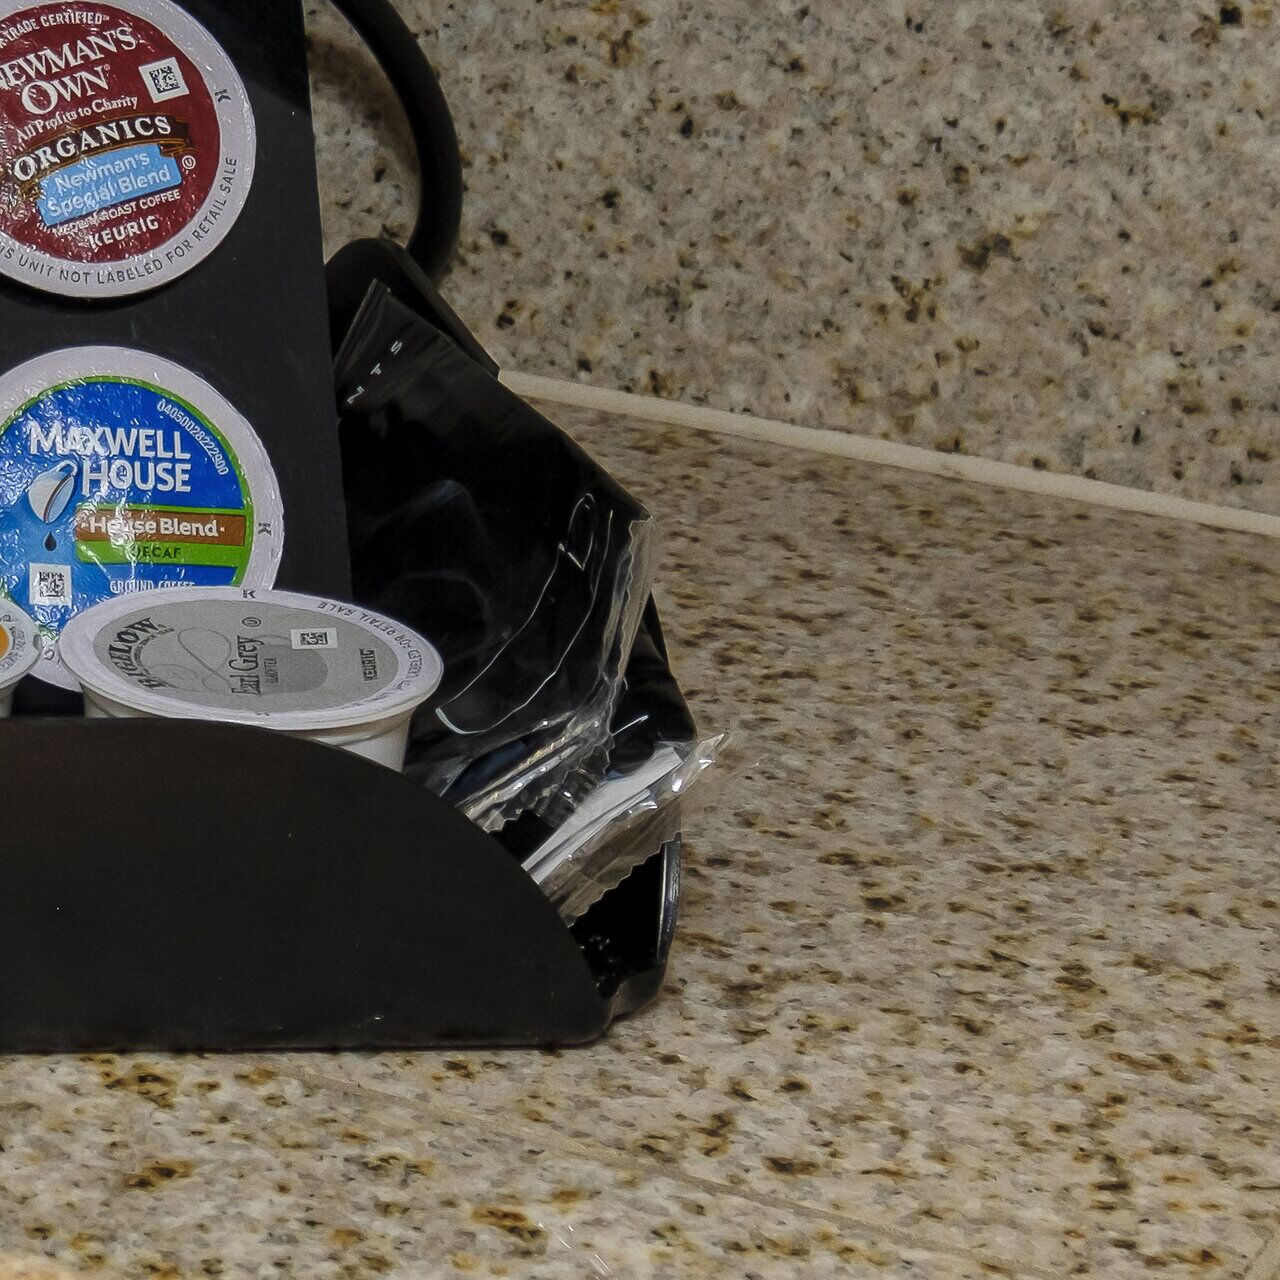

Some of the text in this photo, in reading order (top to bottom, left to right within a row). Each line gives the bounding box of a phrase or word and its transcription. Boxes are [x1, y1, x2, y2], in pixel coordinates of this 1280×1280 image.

[5, 18, 41, 41] TRADE
[16, 125, 36, 143] All
[35, 110, 78, 133] Profits
[78, 106, 92, 118] to
[91, 94, 139, 114] Charity
[14, 116, 172, 181] ORGANICS
[46, 165, 172, 217] Special Blend
[54, 151, 151, 194] Newman's
[19, 254, 55, 277] UNIT
[59, 270, 91, 284] NOT
[96, 258, 163, 284] LABELED
[165, 239, 194, 264] FOR
[192, 196, 228, 242] RETAIL
[220, 156, 238, 194] SALE
[100, 202, 137, 221] ROAST
[140, 190, 181, 210] COFFEE
[90, 215, 160, 250] KEURIG
[27, 420, 192, 460] MAXWELL
[81, 459, 192, 496] HOUSE
[160, 517, 219, 537] Blend
[109, 579, 154, 594] GROUND
[108, 617, 172, 690] BIGELOW
[228, 635, 266, 696] Earl Grey
